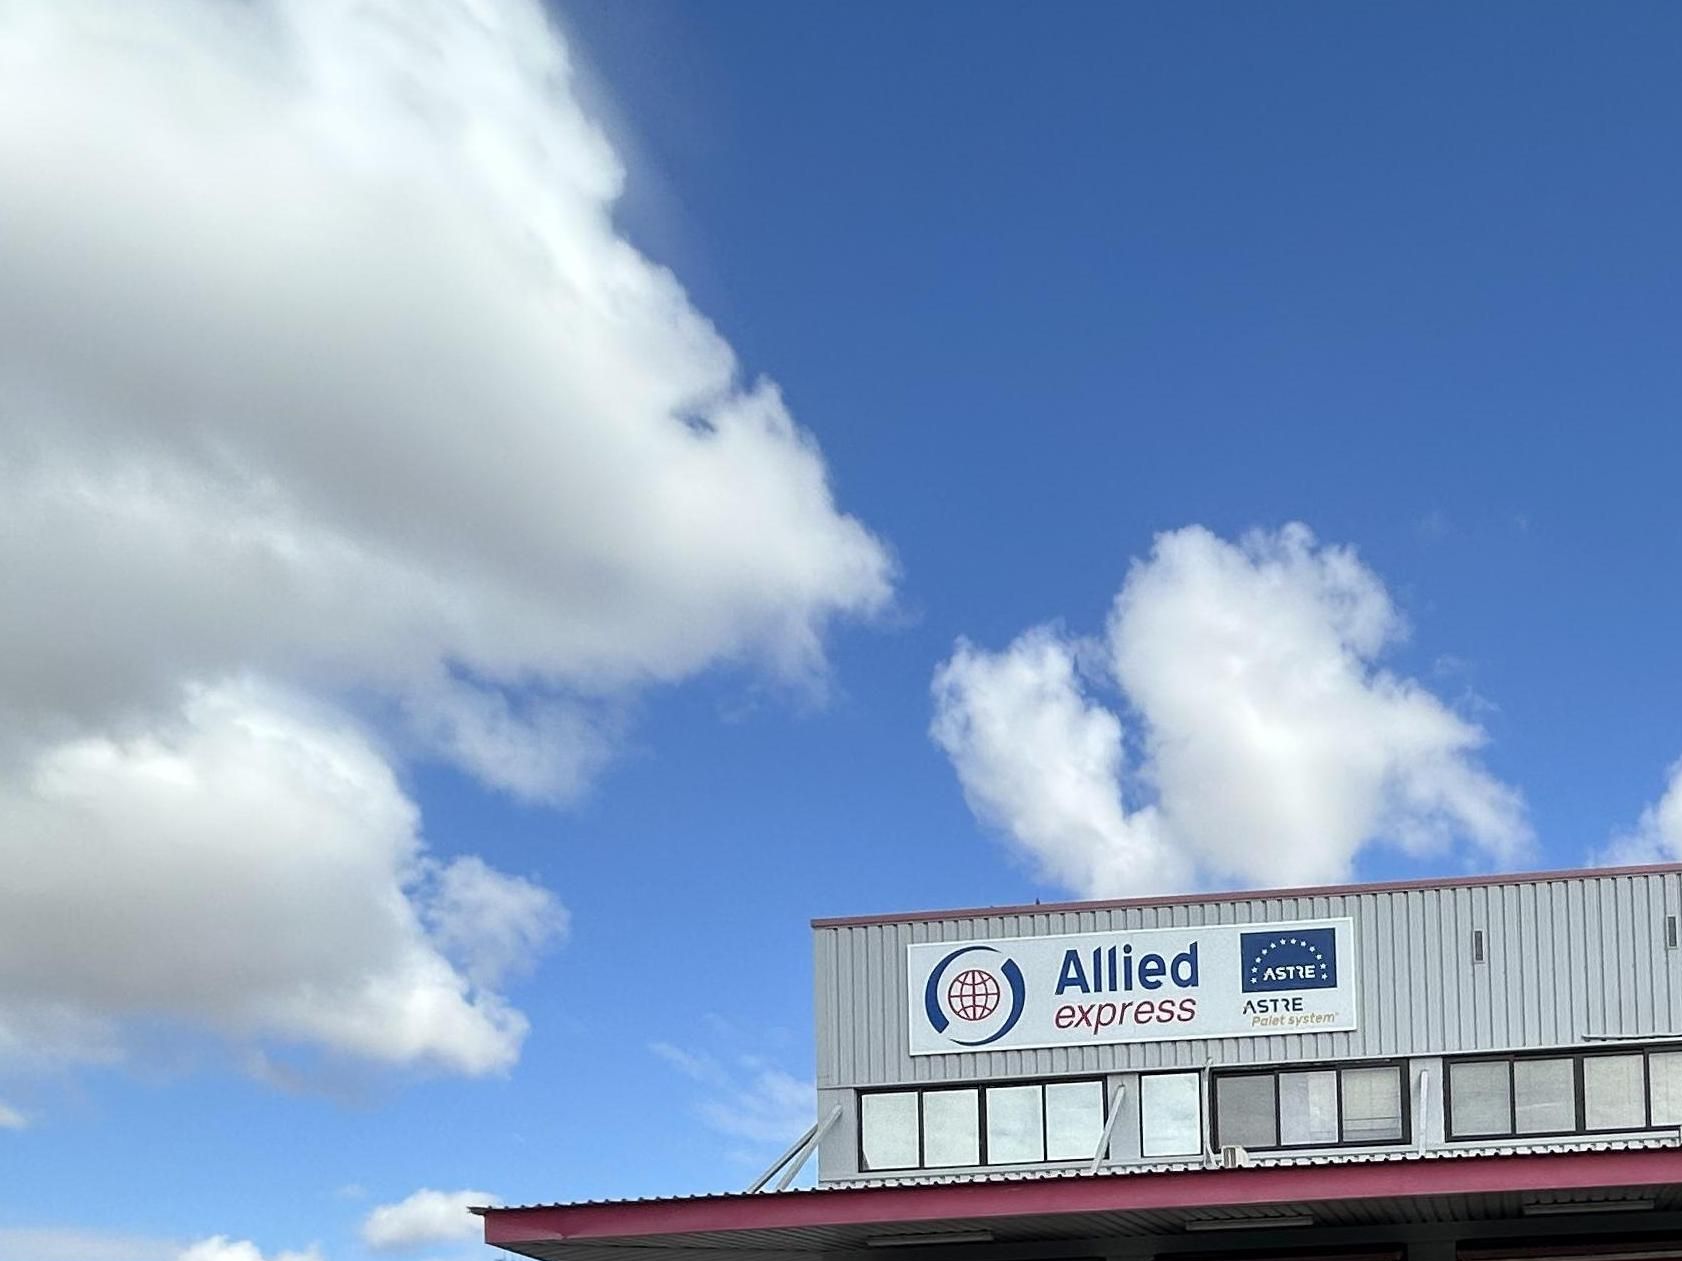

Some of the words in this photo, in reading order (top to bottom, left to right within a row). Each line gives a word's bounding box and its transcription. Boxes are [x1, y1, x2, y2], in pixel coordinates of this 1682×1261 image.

[1055, 941, 1199, 995] Allied
[1263, 965, 1316, 981] ASTRE
[1243, 997, 1303, 1014] ASTRE
[1055, 999, 1197, 1035] express
[1252, 1014, 1285, 1026] Palet
